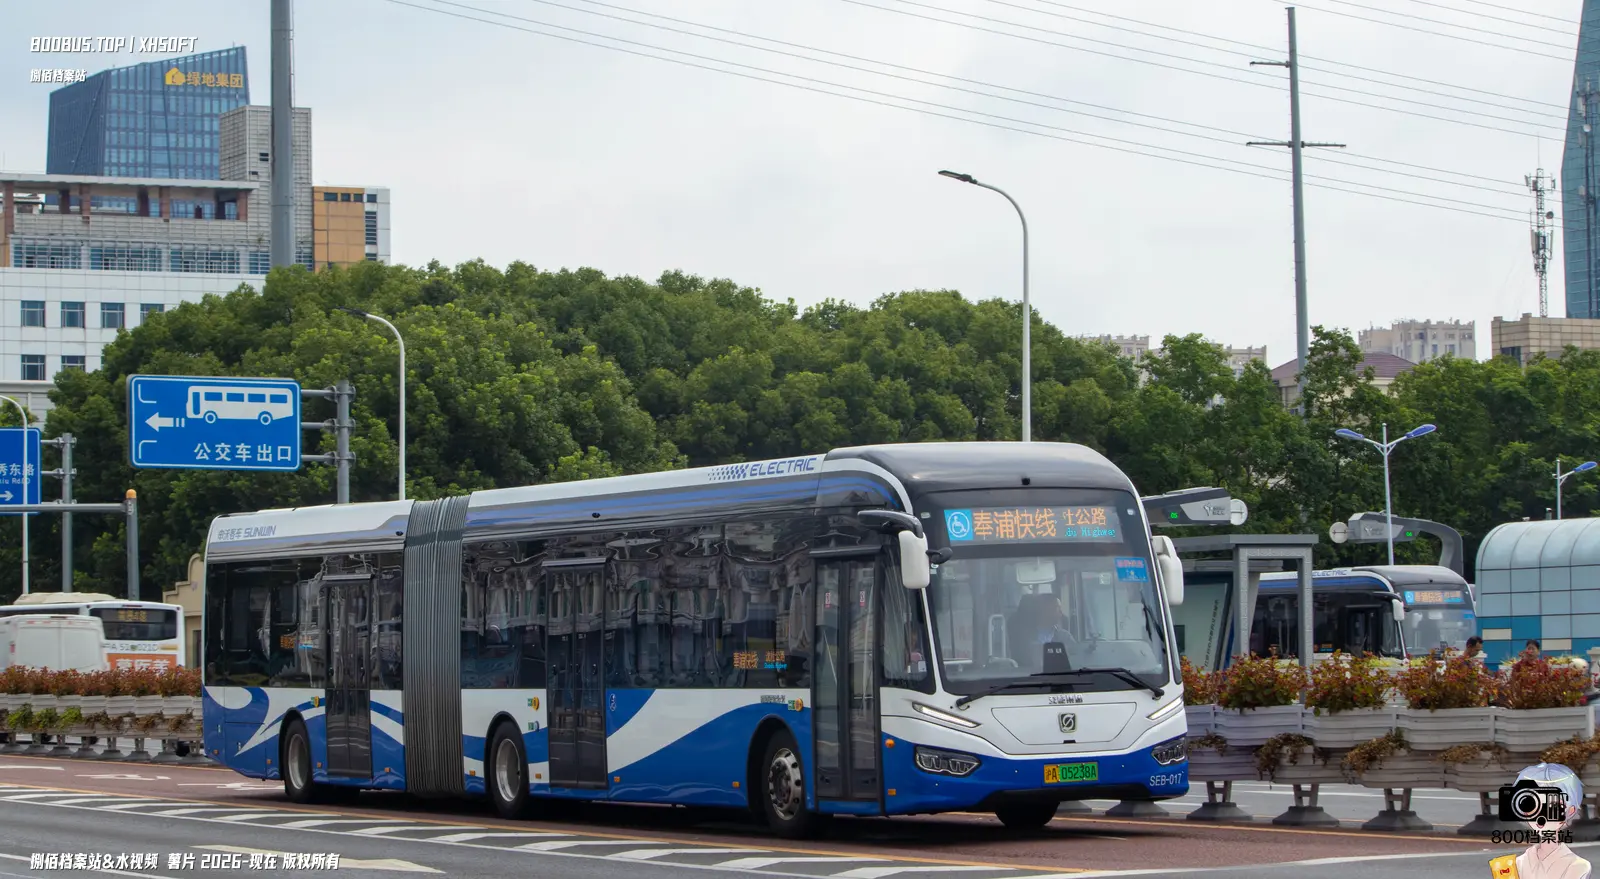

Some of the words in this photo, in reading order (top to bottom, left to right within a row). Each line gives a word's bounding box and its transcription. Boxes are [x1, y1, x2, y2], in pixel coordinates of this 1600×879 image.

[186, 72, 244, 88] 绿地集团
[194, 442, 292, 462] 公交车出口
[750, 458, 816, 476] ELECTRIC
[243, 525, 276, 538] SUNWIN
[973, 508, 1057, 539] 奉浦快线
[1150, 773, 1182, 787] SEB-017
